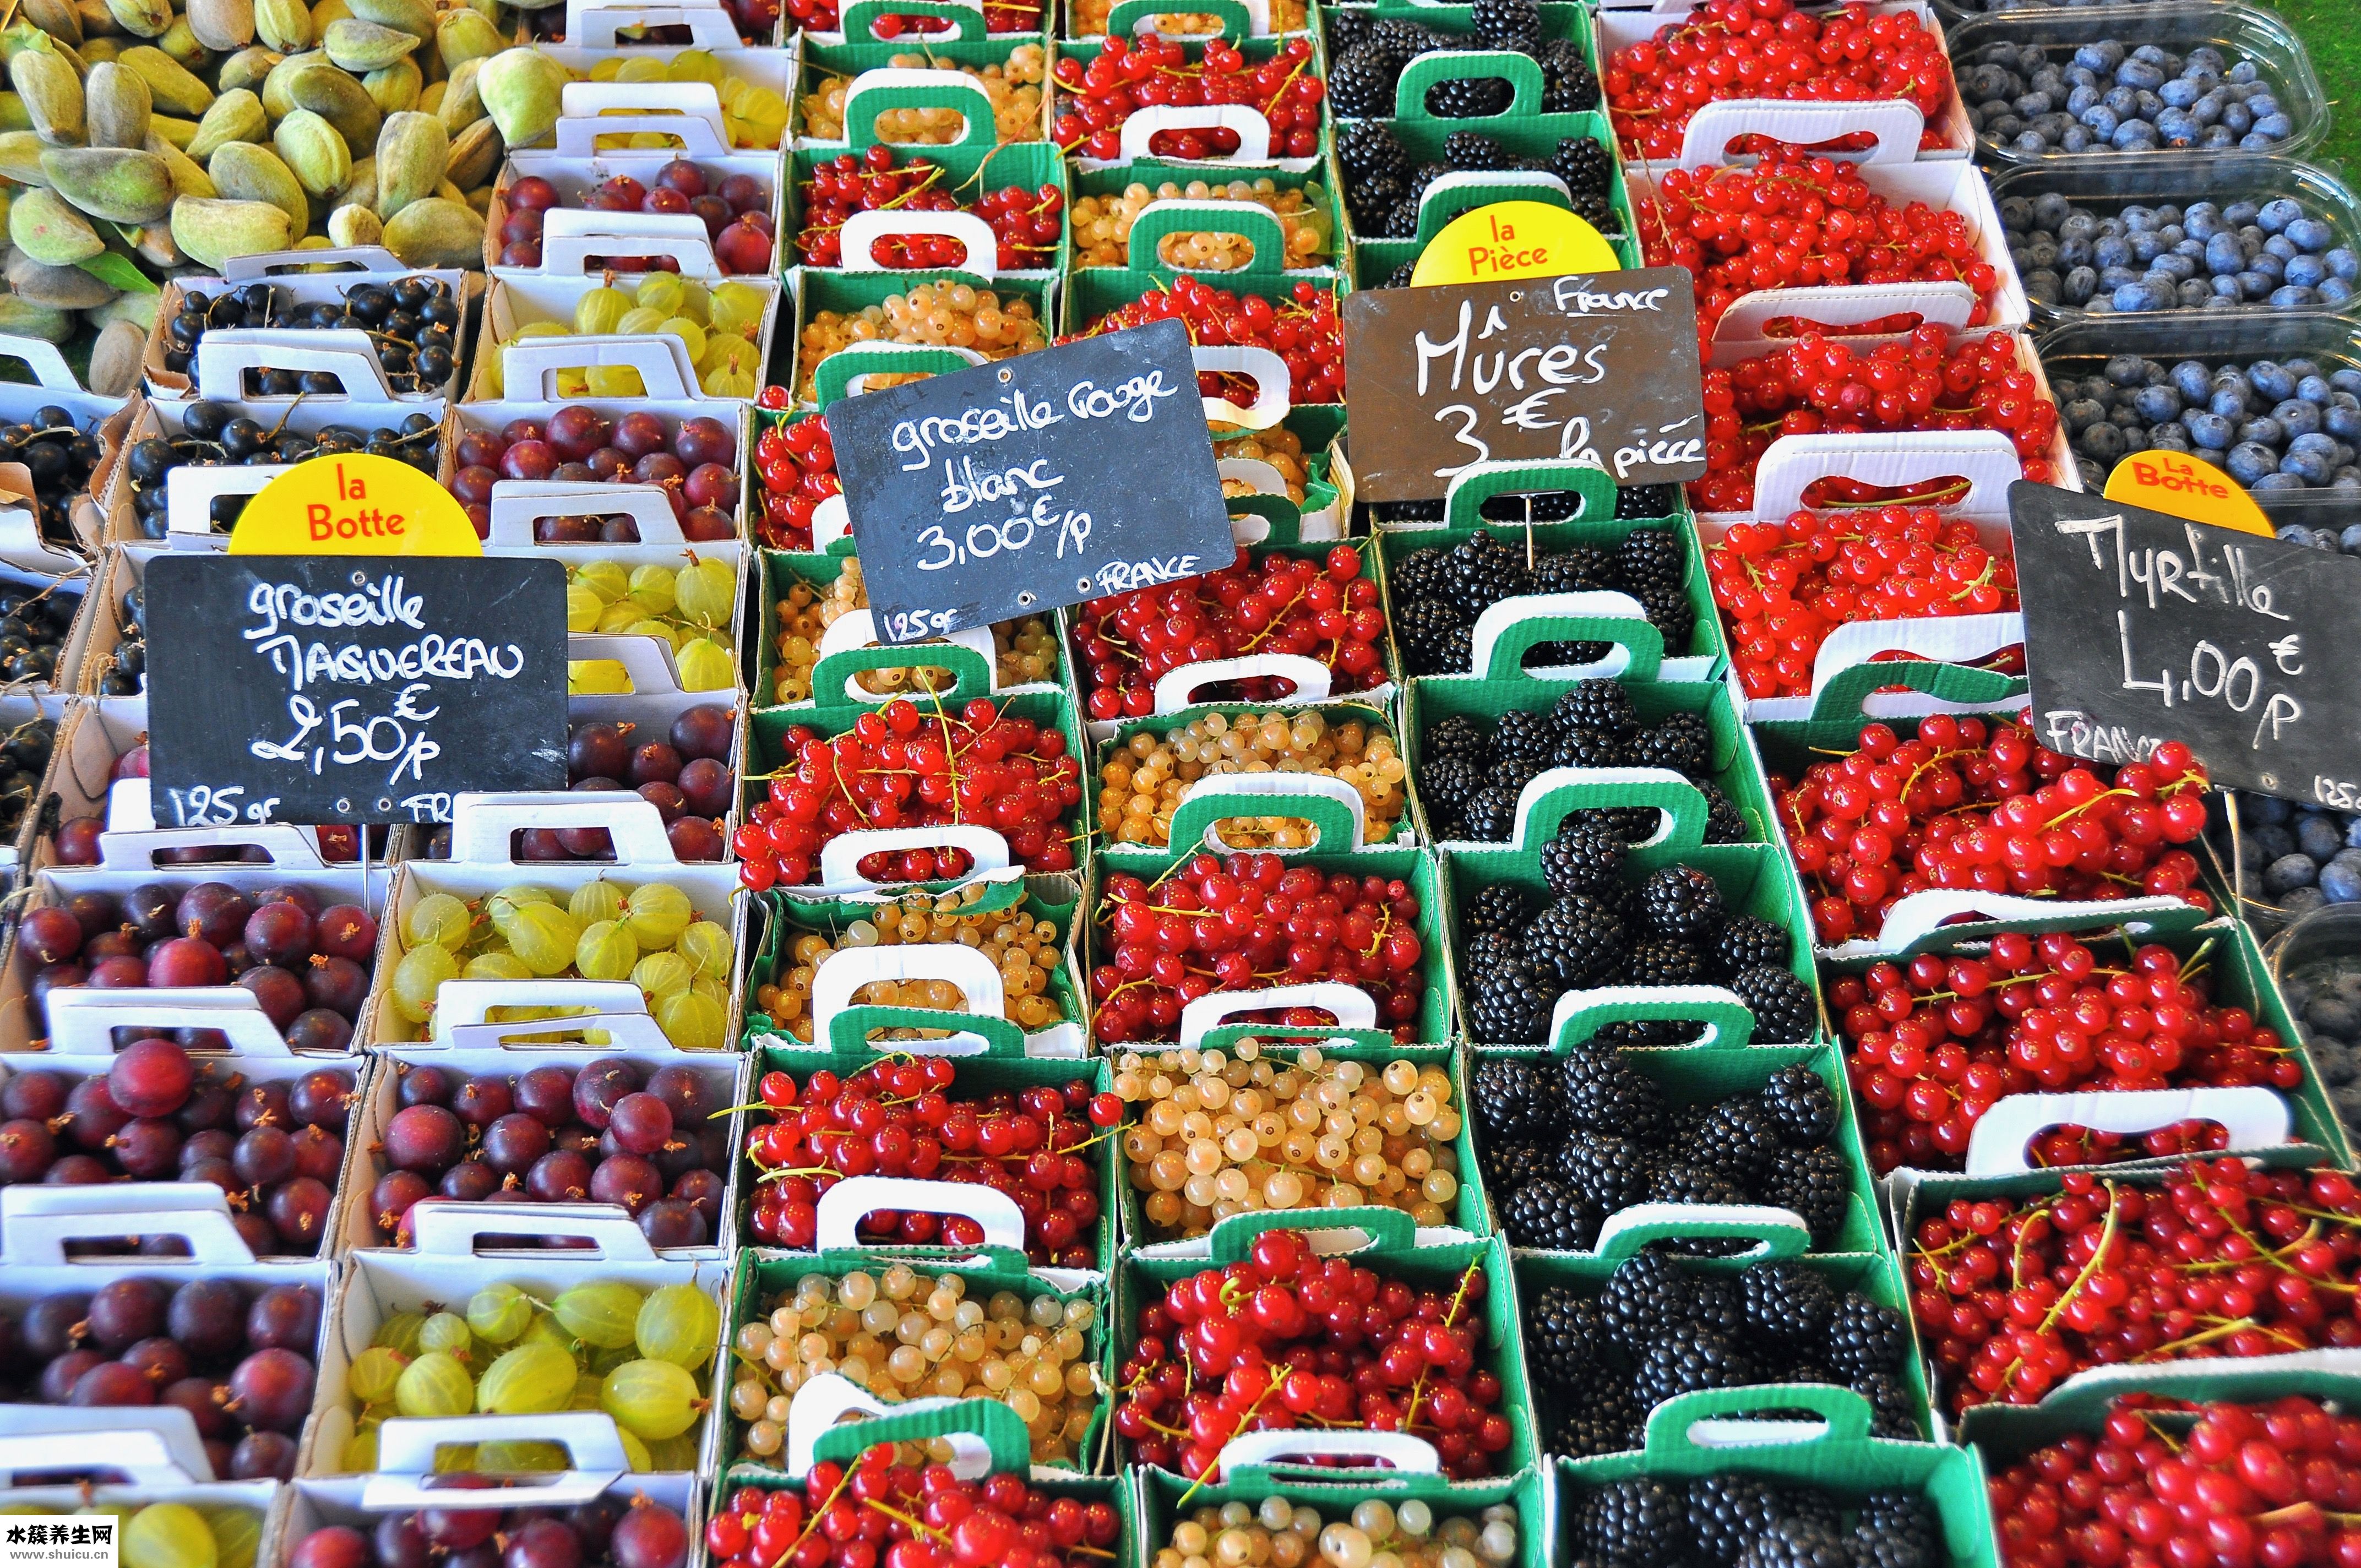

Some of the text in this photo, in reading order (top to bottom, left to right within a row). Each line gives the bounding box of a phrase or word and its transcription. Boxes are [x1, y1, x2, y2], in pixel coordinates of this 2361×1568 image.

[1489, 215, 1515, 243] la
[1468, 247, 1548, 276] Pièce
[1553, 275, 1669, 313] France
[1415, 300, 1607, 396] Mûres
[892, 389, 1065, 471] groseille
[1433, 404, 1489, 477] 3
[1501, 388, 1566, 433] €
[1559, 416, 1604, 467] la
[336, 463, 366, 500] la
[940, 454, 1065, 513] blanc
[2131, 462, 2229, 499] Botte
[2163, 458, 2194, 475] La
[308, 502, 405, 541] Botte
[1095, 554, 1200, 595] FRANCE
[244, 575, 426, 639] groseille
[256, 634, 525, 690] MAQUEREAU
